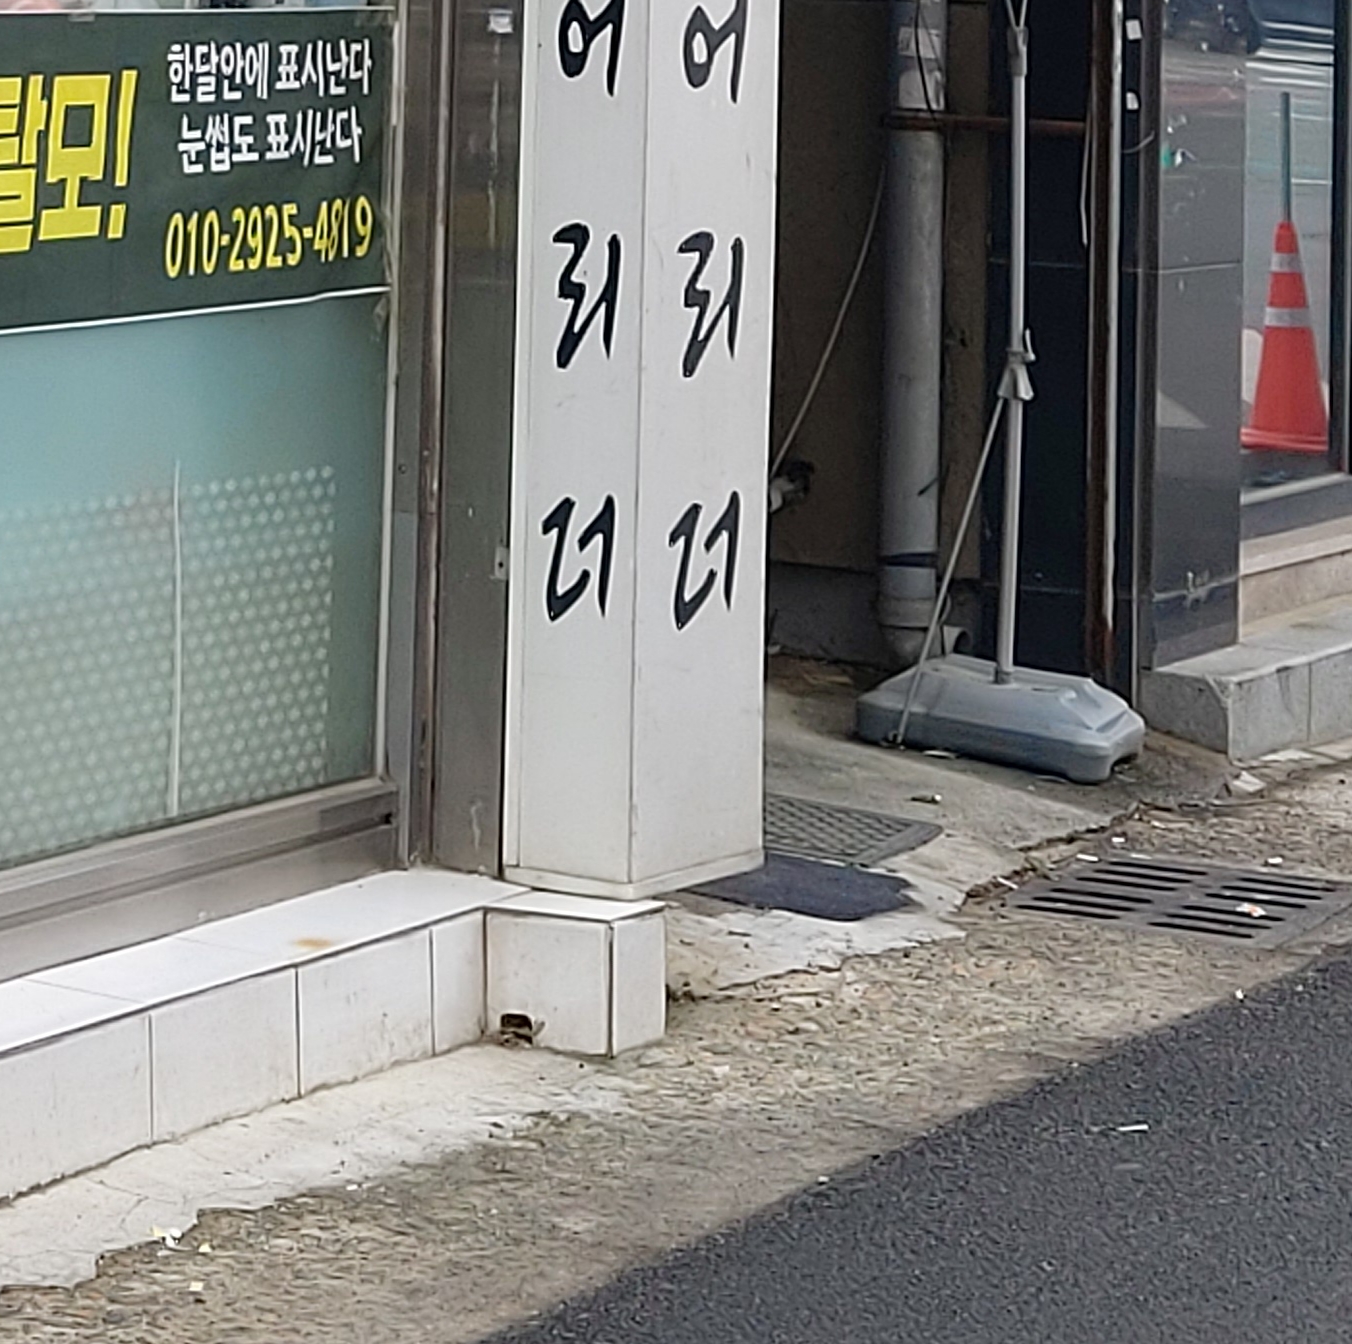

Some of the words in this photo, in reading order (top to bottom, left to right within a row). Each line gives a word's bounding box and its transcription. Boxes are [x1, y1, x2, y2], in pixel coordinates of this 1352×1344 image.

[167, 40, 269, 103] 한달안에
[275, 38, 373, 98] 표시난다
[177, 112, 260, 174] 눈썹도
[264, 106, 363, 169] 표시난다
[165, 195, 374, 279] 010-2925-4819
